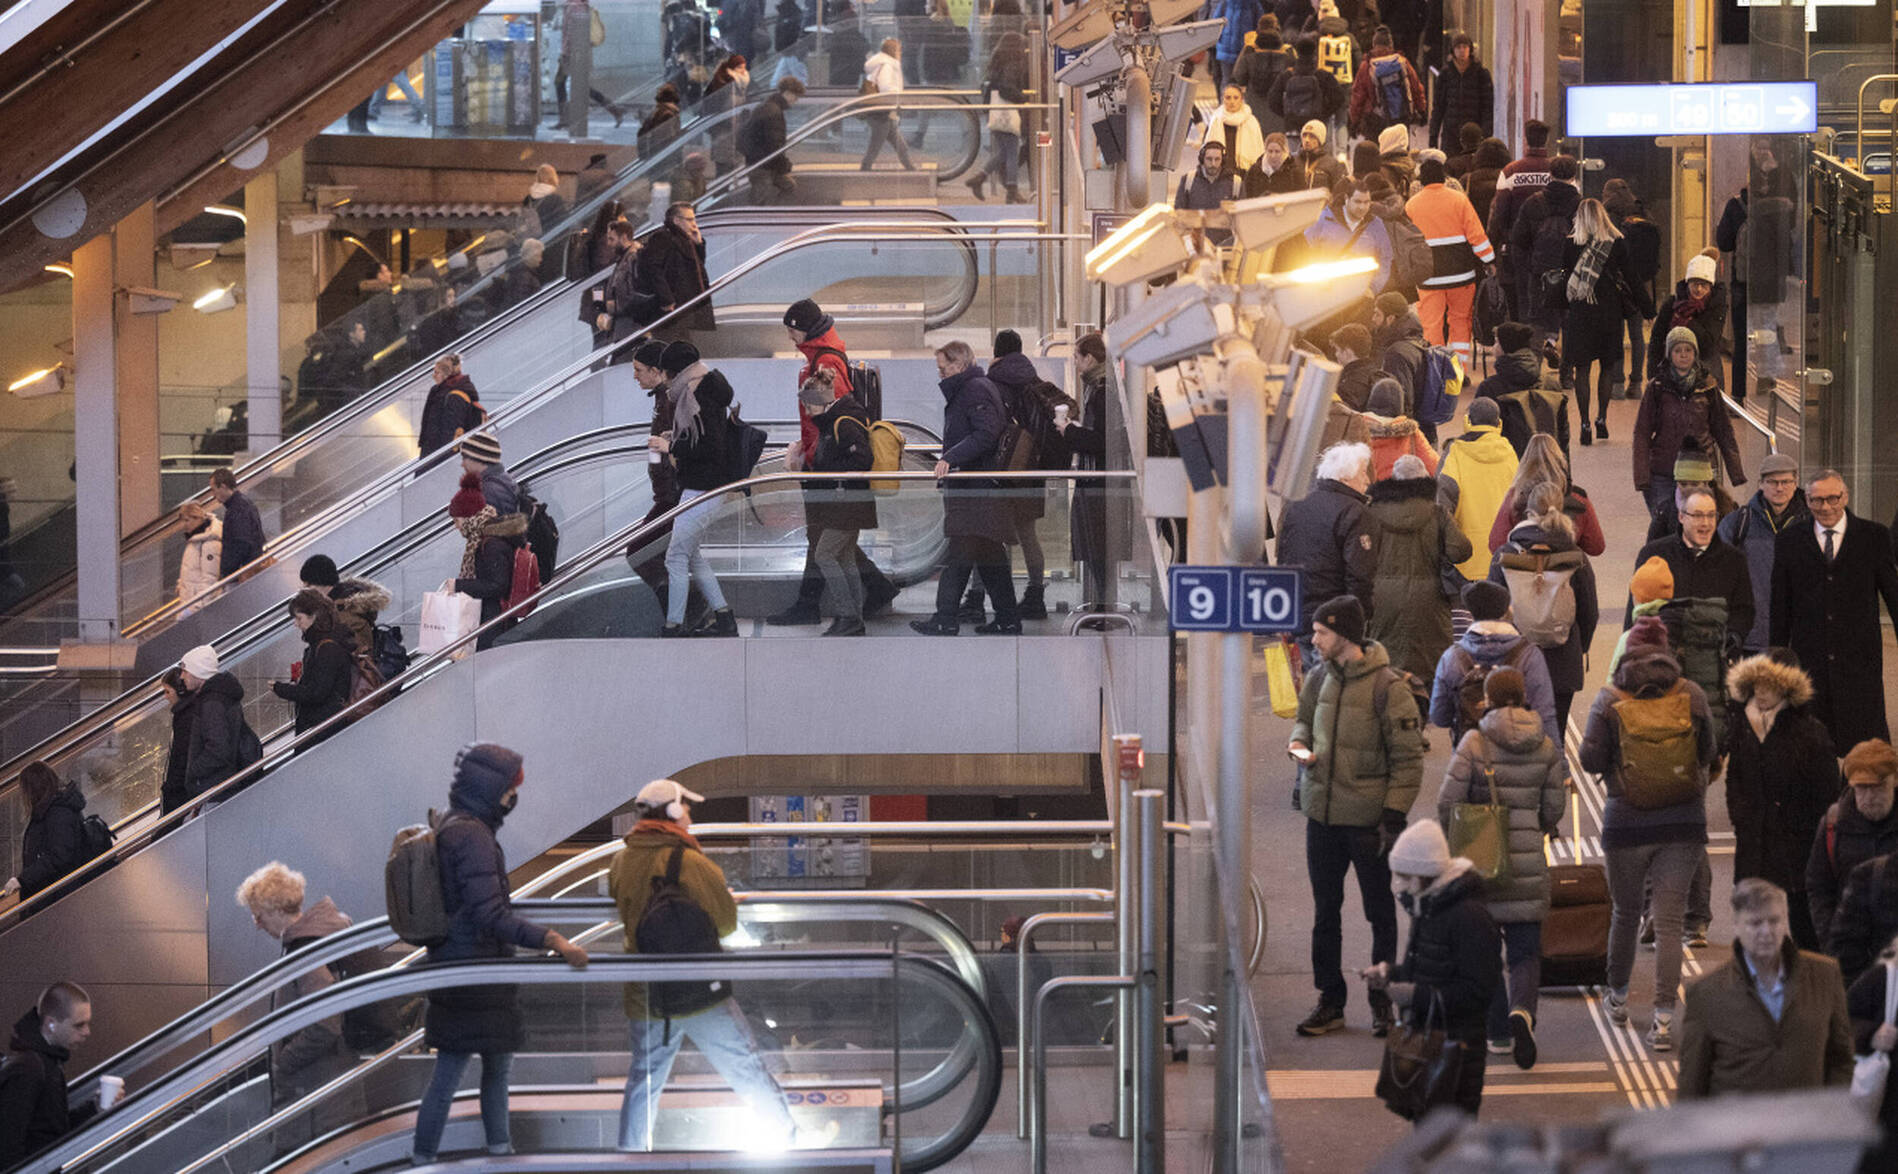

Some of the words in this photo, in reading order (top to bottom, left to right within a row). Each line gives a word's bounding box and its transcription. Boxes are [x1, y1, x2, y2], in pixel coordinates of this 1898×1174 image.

[1727, 103, 1758, 126] 50
[1188, 586, 1215, 620] 9
[1247, 587, 1291, 621] 10
